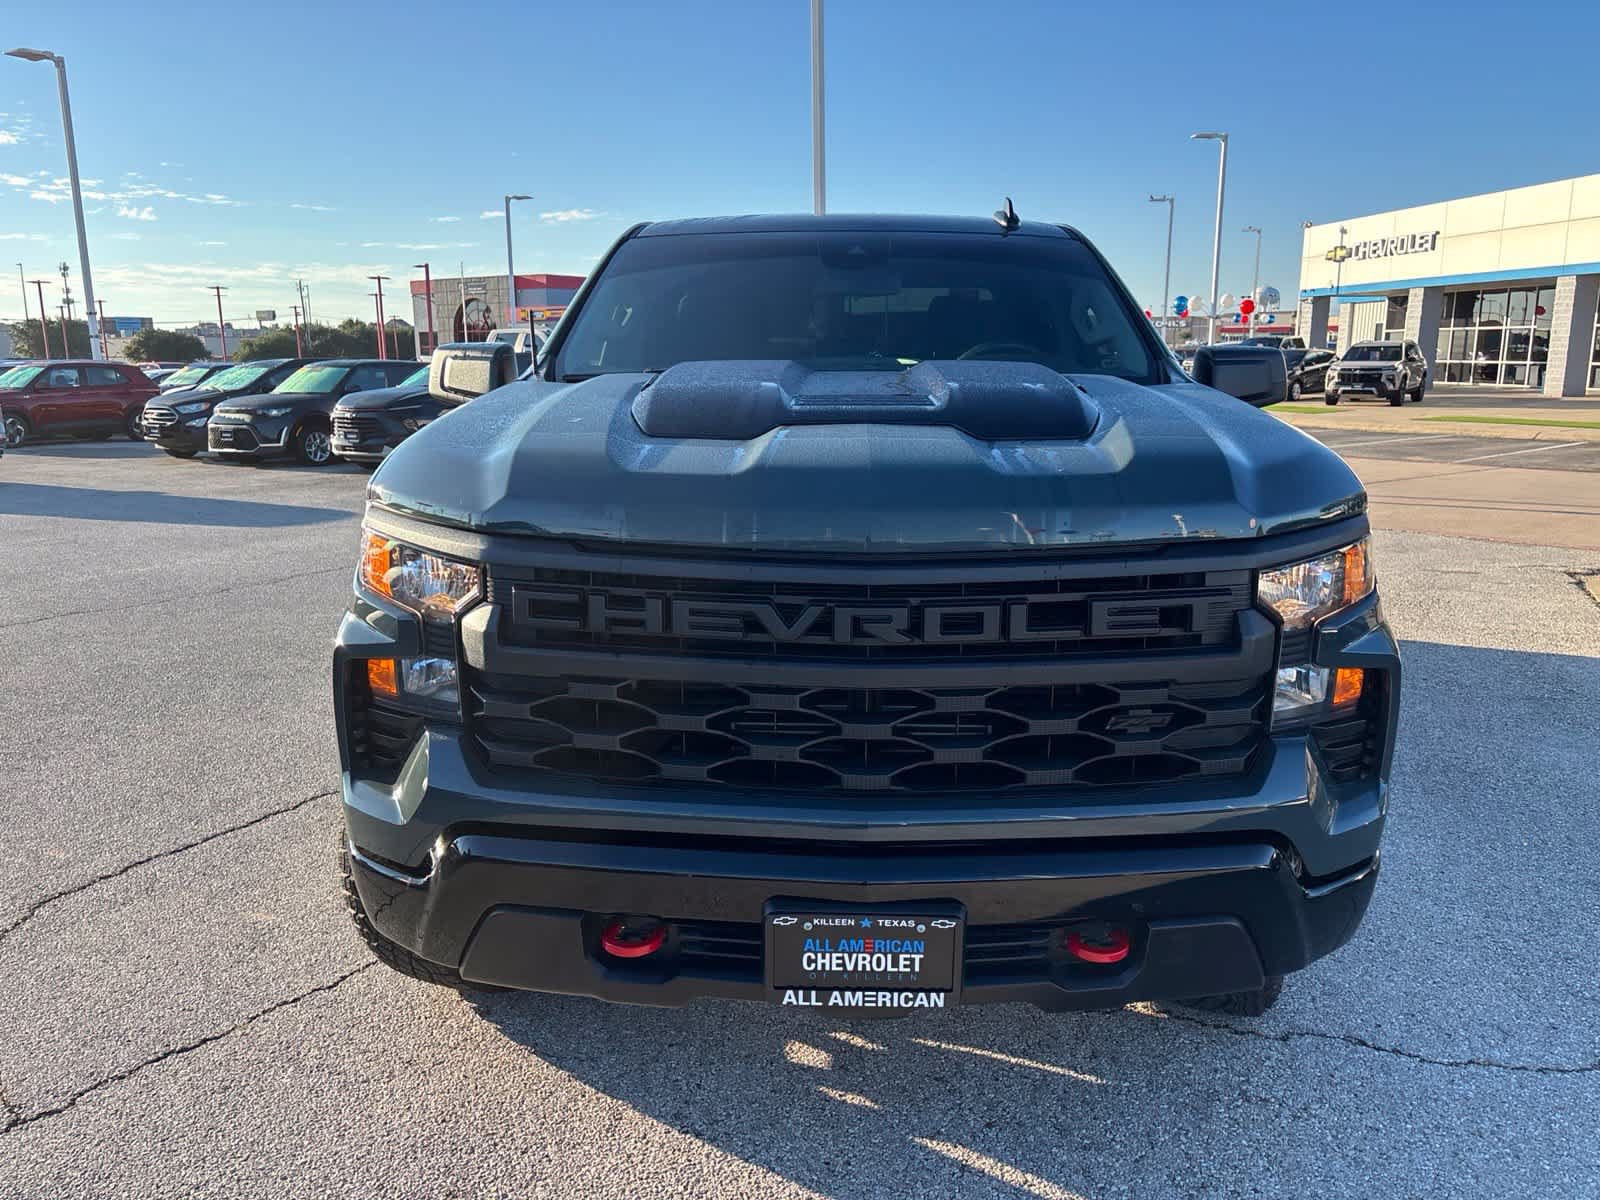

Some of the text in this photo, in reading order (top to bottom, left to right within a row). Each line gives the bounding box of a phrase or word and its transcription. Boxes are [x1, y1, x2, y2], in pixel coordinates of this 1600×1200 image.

[1352, 231, 1440, 260] CHEVROLET
[512, 584, 1233, 643] CHEVROLET
[813, 918, 916, 928] KILLEEN TEXAS
[803, 938, 925, 953] ALL AMERICAN
[802, 952, 924, 972] CHEVROLET
[782, 989, 945, 1007] ALL AMERICAN
